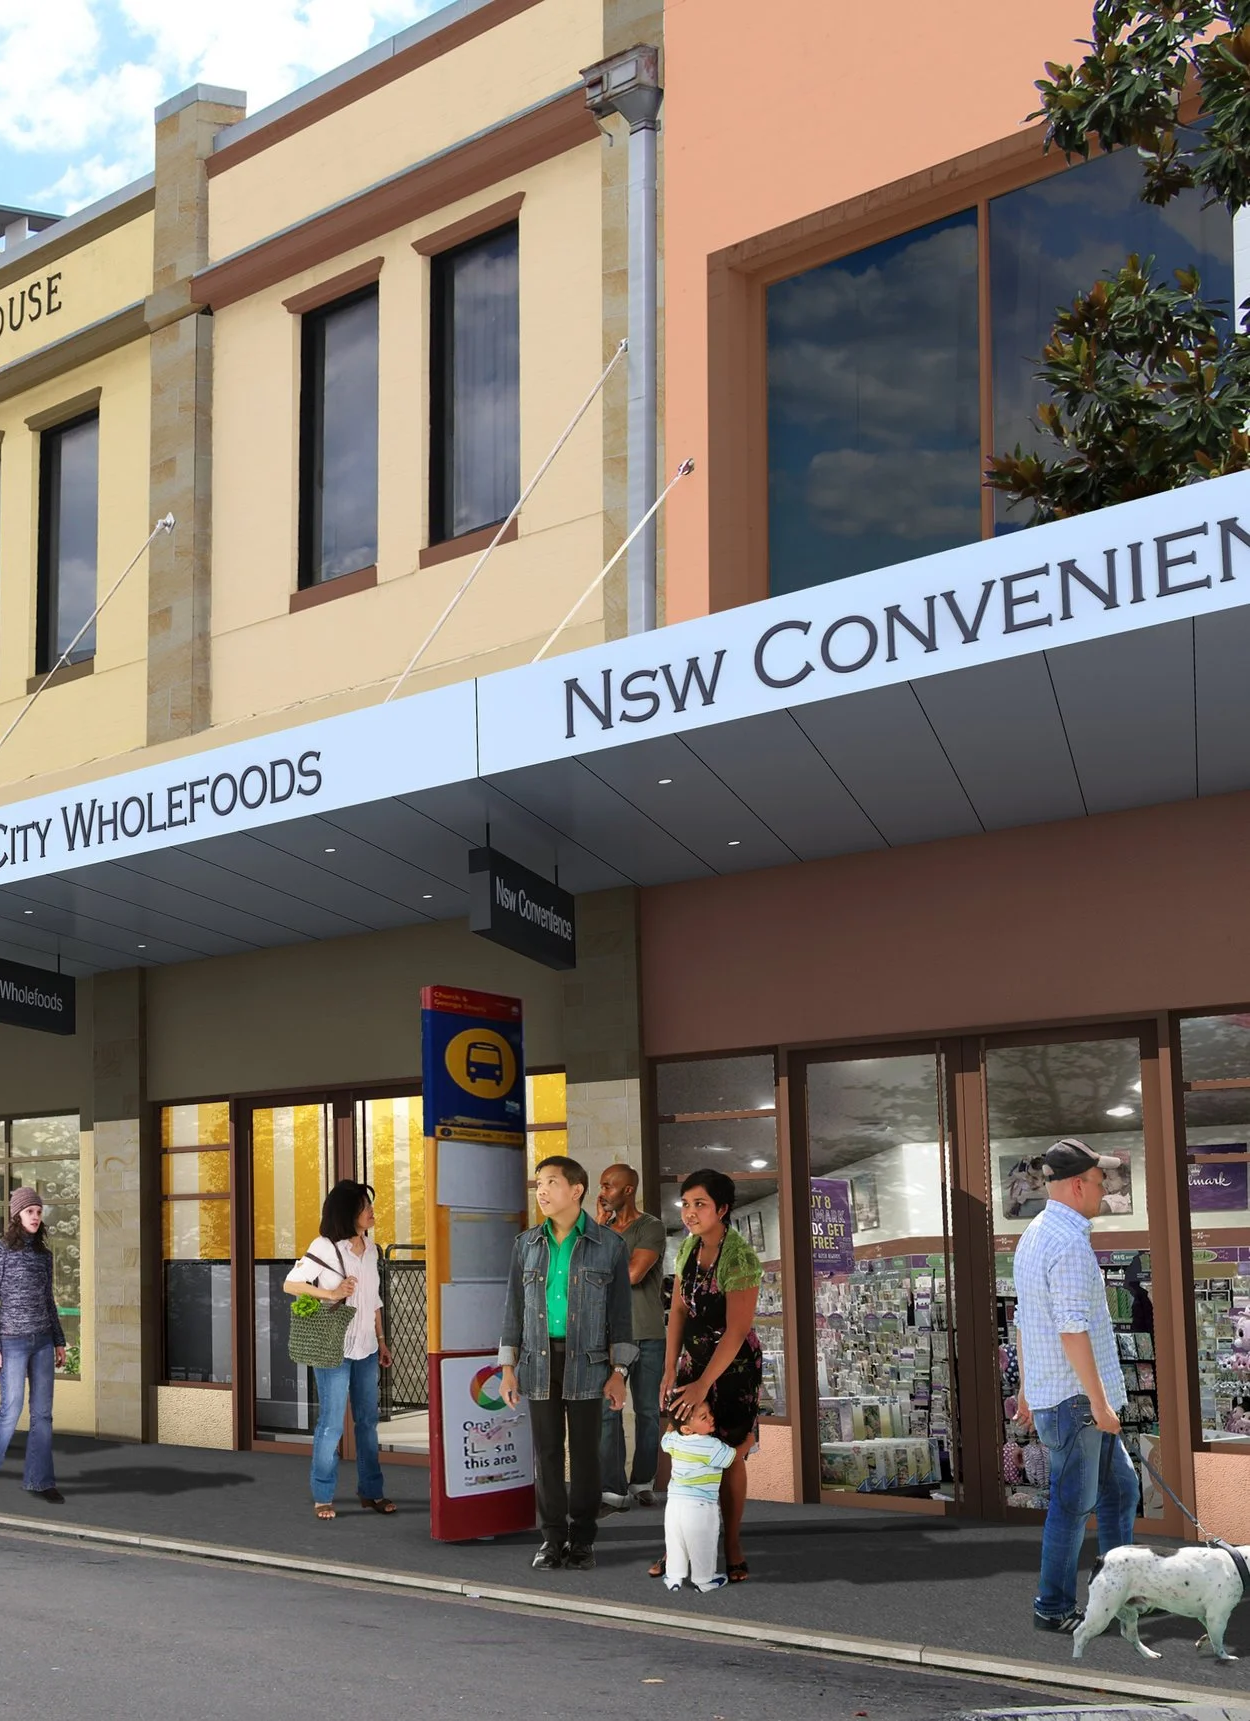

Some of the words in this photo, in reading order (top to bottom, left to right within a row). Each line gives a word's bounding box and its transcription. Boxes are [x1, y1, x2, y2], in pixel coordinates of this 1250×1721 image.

[61, 750, 323, 852] WHOLEFOODS
[495, 876, 517, 912] Nsw
[518, 889, 572, 941] Convenience
[0, 979, 63, 1013] Wholefoods
[1188, 1172, 1232, 1187] lmark
[812, 1208, 846, 1223] LMARK
[827, 1223, 845, 1236] GET
[464, 1457, 490, 1469] this
[493, 1454, 518, 1466] area
